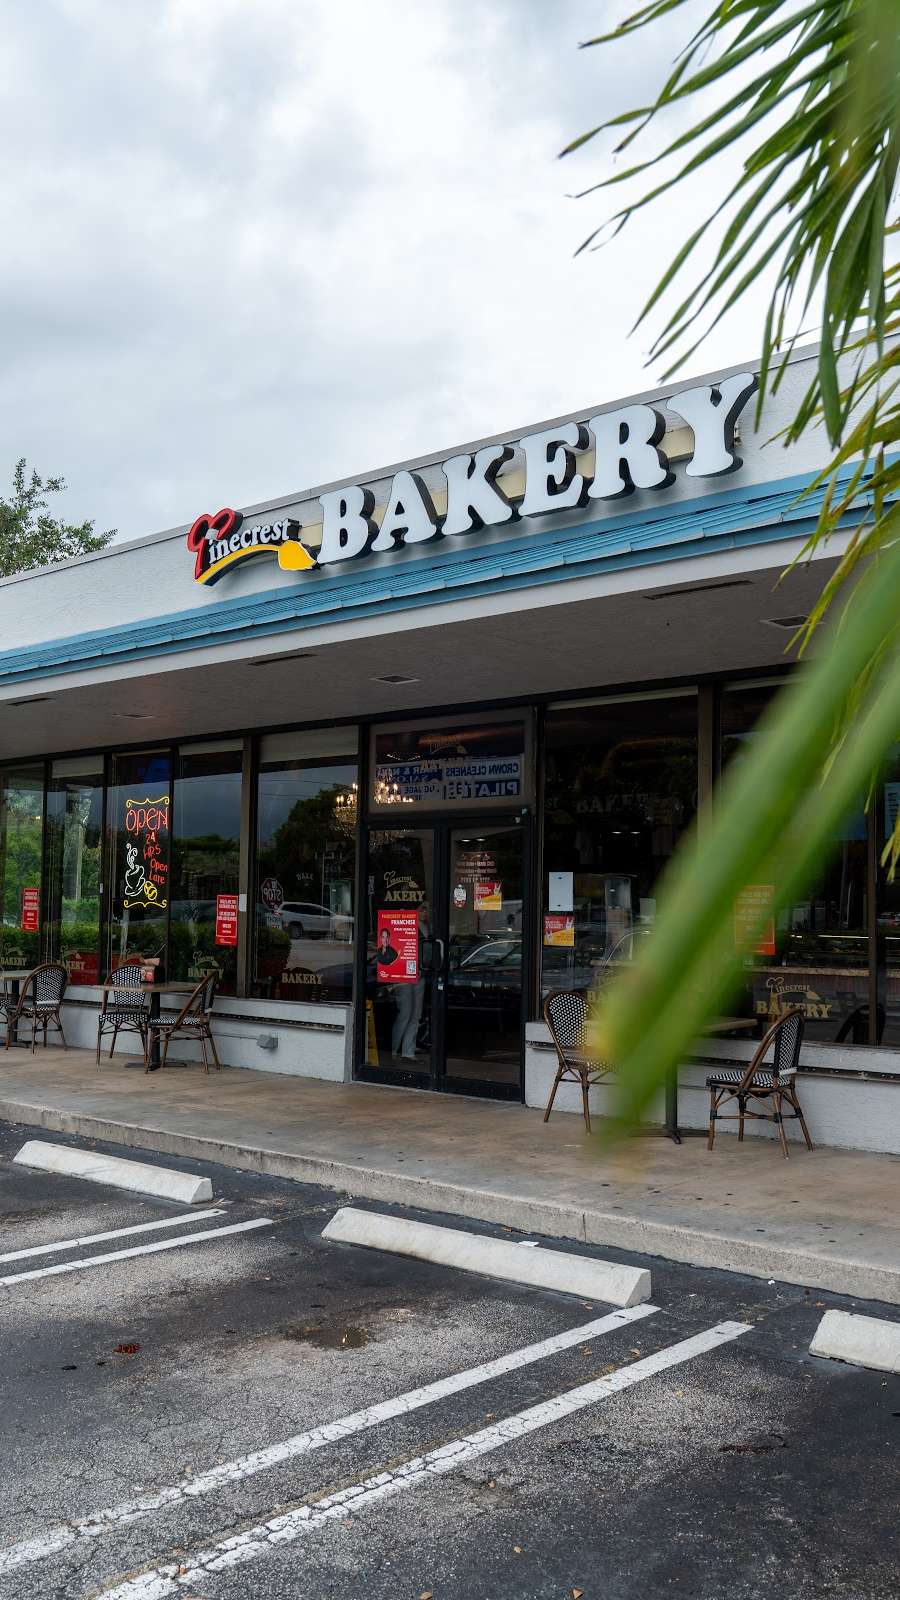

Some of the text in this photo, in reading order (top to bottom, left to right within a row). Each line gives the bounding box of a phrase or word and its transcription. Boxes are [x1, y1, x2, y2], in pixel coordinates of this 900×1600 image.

[317, 372, 756, 564] BAKERY
[126, 807, 169, 836] OPEN
[281, 972, 323, 985] BAKERY
